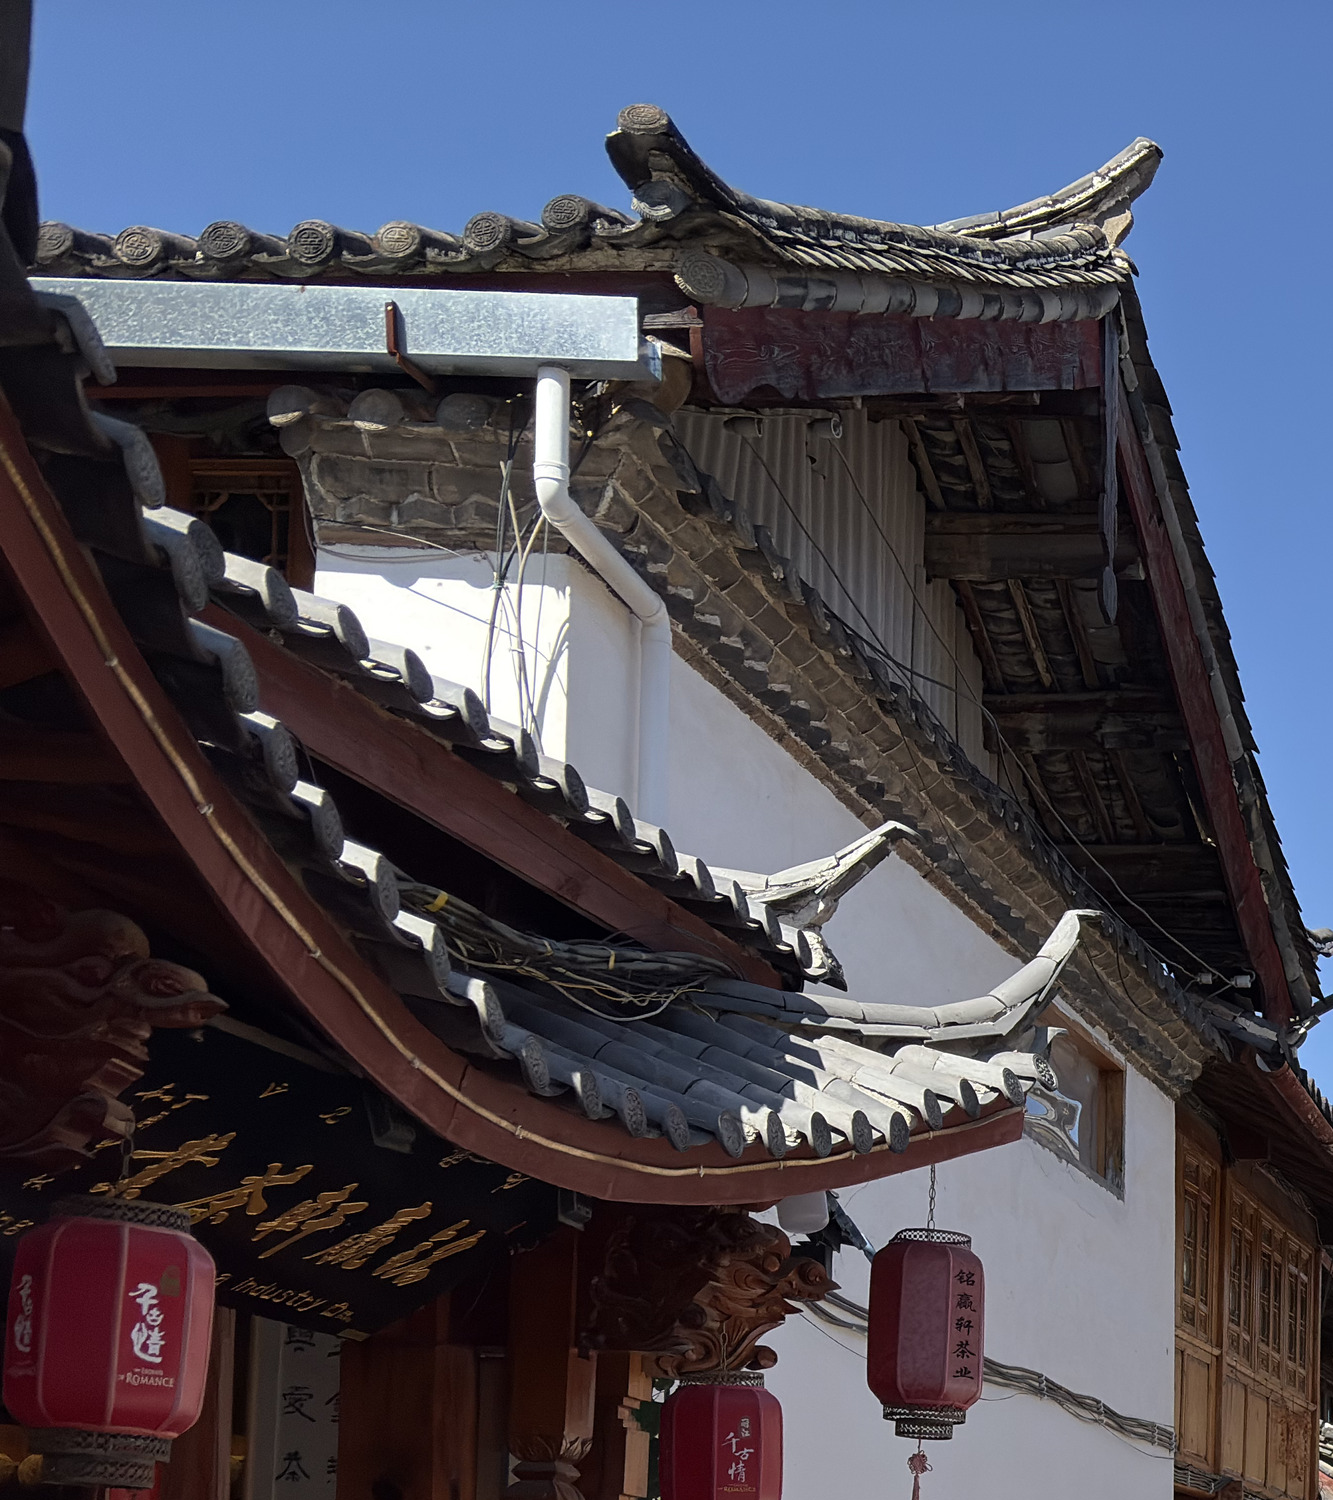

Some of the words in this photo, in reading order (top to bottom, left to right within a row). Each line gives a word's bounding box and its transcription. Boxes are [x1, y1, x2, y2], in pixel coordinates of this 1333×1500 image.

[230, 1276, 328, 1312] Industry
[128, 1282, 166, 1364] 千古情
[953, 1269, 977, 1380] 铭赢轩茶业
[125, 1371, 176, 1388] ROMANCE
[721, 1432, 755, 1482] 千古情
